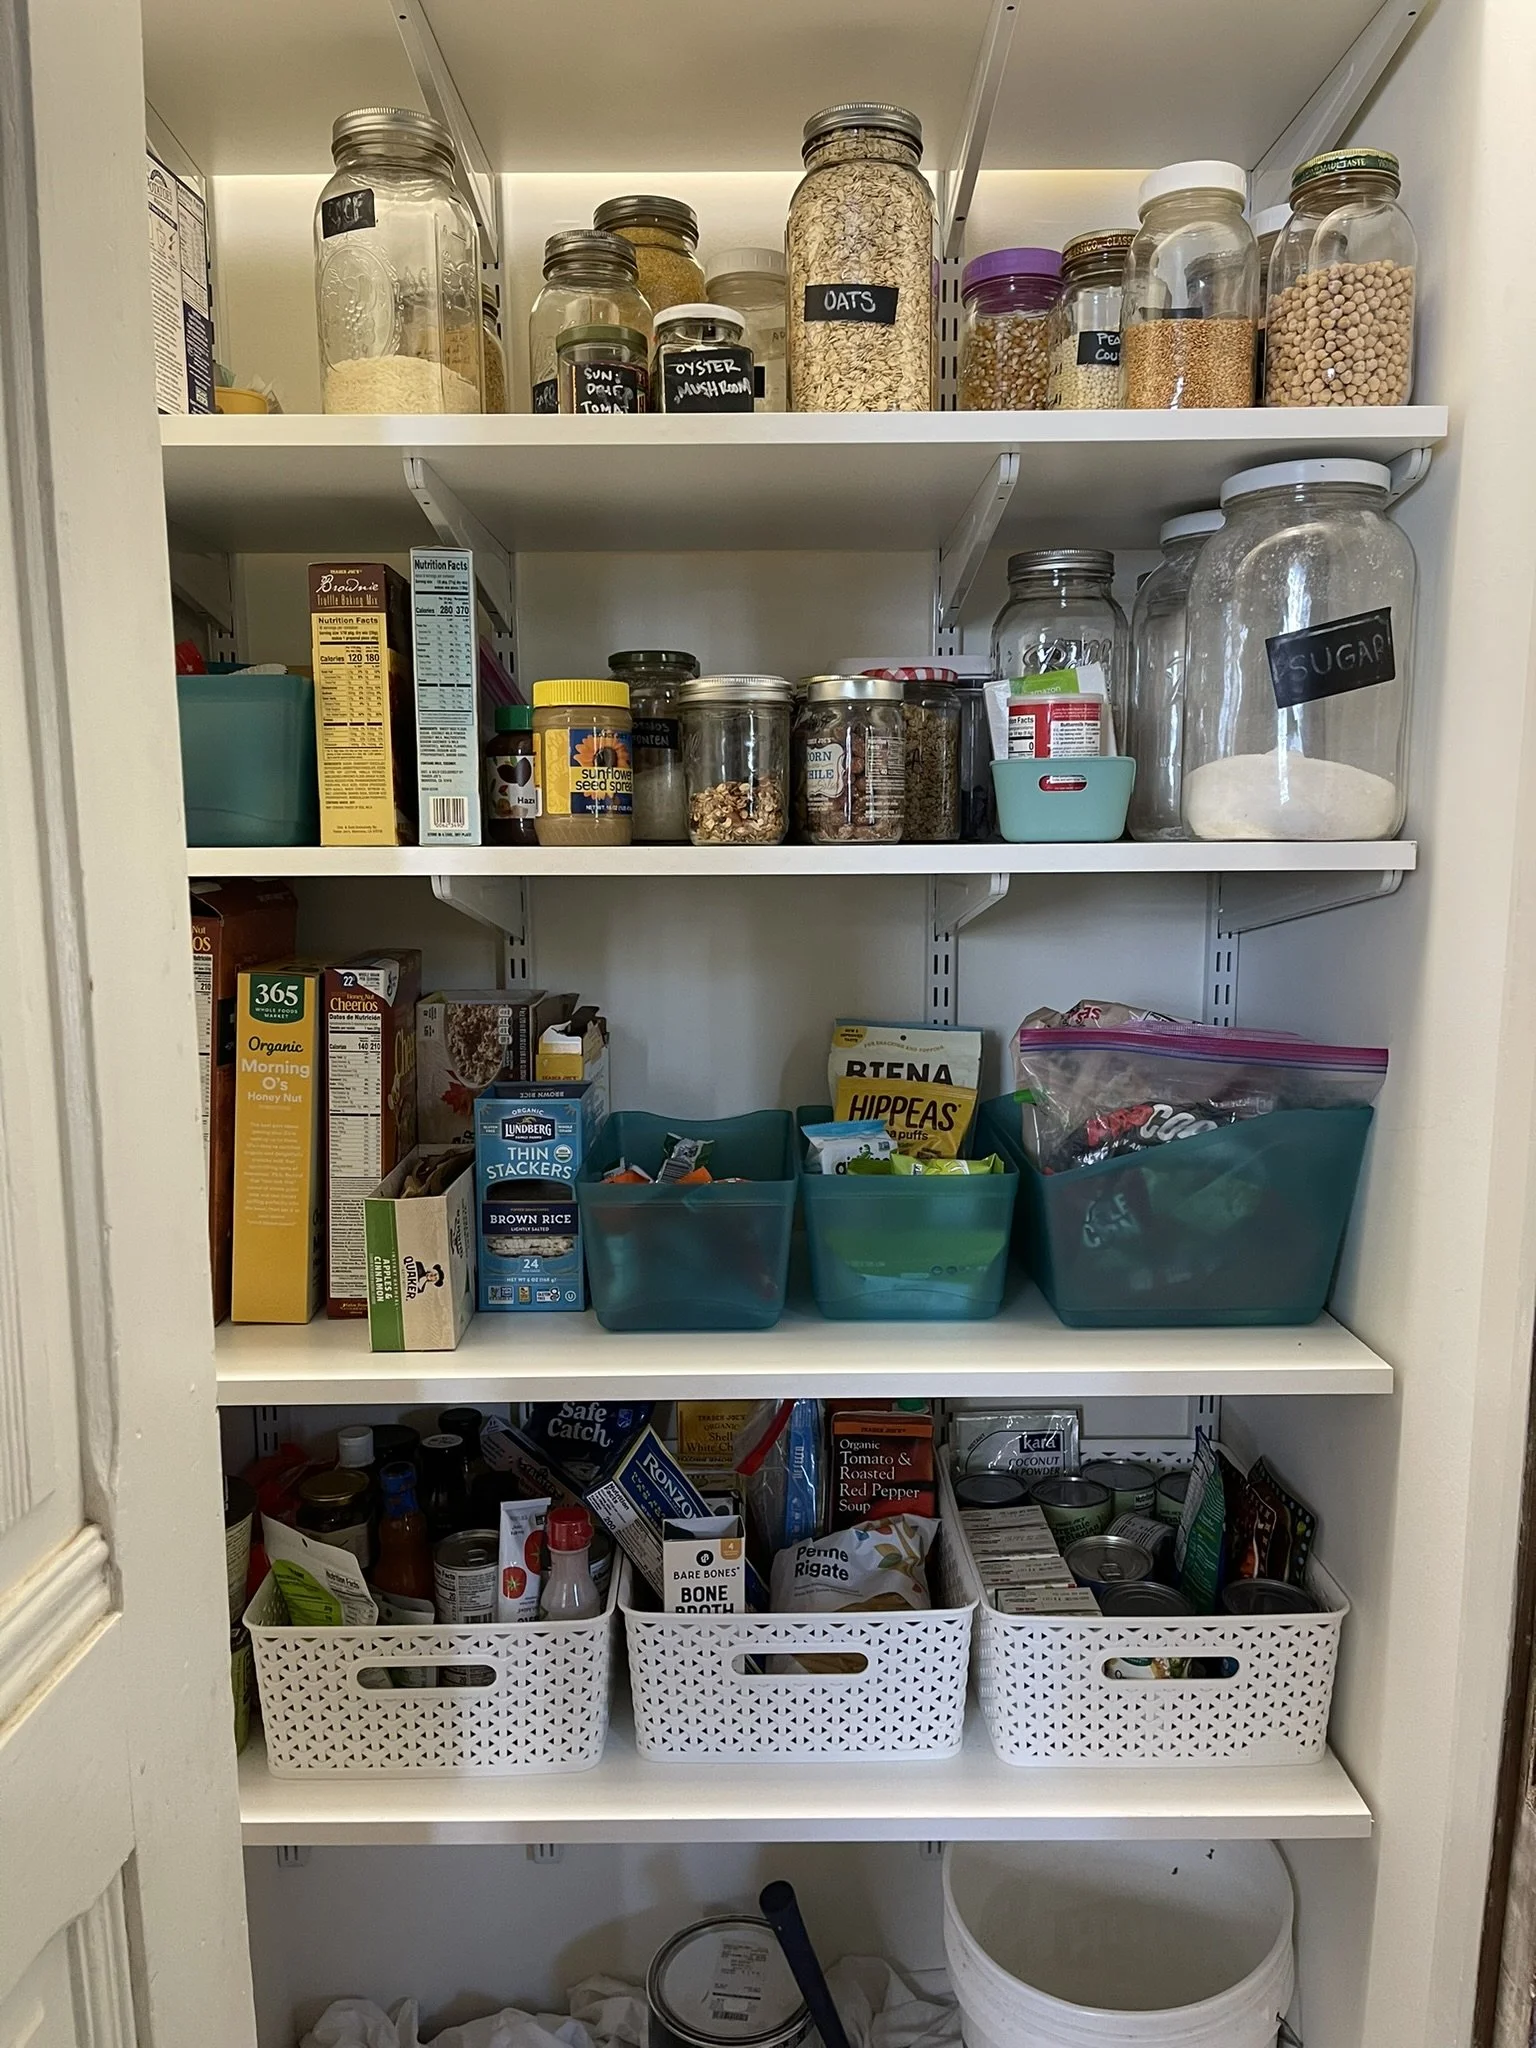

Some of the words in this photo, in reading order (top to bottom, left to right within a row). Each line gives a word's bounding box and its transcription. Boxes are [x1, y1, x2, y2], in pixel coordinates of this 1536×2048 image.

[824, 290, 877, 313] OATS
[675, 359, 742, 377] OYSTER
[676, 377, 753, 400] MUSHROOM
[414, 560, 447, 570] Nutrition
[447, 560, 468, 571] Facts
[316, 574, 379, 593] Brownie
[317, 594, 339, 606] Truffle
[341, 594, 364, 608] Baking
[366, 594, 378, 606] Mix
[440, 605, 453, 614] 280
[455, 606, 470, 615] 370
[318, 617, 354, 625] Nutrition
[356, 617, 379, 625] Facts
[348, 653, 363, 662] 120
[365, 653, 380, 662] 180
[1288, 633, 1386, 679] SUGAR
[1017, 716, 1034, 724] Facts
[582, 768, 632, 781] sunflower
[575, 780, 607, 791] seed
[342, 975, 355, 987] 22
[254, 982, 299, 1007] 365
[329, 997, 379, 1012] Cheerios
[249, 1036, 304, 1057] Organic
[358, 1042, 369, 1050] 140
[370, 1042, 381, 1050] 210
[241, 1058, 311, 1078] Morning
[262, 1076, 288, 1091] O's
[247, 1092, 281, 1104] Honey
[283, 1093, 303, 1103] Nut
[511, 1107, 545, 1116] ORGANIC
[848, 1095, 957, 1131] HIPPEAS
[504, 1123, 552, 1138] LUNDBERG
[898, 1129, 929, 1141] puffs
[507, 1147, 549, 1160] THIN
[486, 1162, 573, 1179] STACKERS
[490, 1215, 538, 1224] BROWN
[542, 1215, 572, 1224] RICE
[523, 1259, 539, 1269] 24
[374, 1256, 384, 1302] CINNAMON
[382, 1259, 393, 1292] APPLES
[404, 1256, 417, 1300] QUAKER
[558, 1402, 608, 1423] Safe
[547, 1418, 612, 1448] Catch
[686, 1442, 714, 1452] White
[839, 1438, 881, 1452] Organic
[1023, 1433, 1056, 1451] kara
[839, 1451, 894, 1465] Tomato
[898, 1452, 912, 1466] &
[1009, 1457, 1060, 1467] COCONUT
[840, 1466, 896, 1481] Roasted
[642, 1453, 697, 1519] RONZO
[840, 1482, 867, 1497] Red
[872, 1482, 920, 1501] Pepper
[608, 1483, 630, 1511] Nutrition
[839, 1499, 871, 1515] Soup
[603, 1516, 616, 1531] 200
[796, 1546, 849, 1563] Penne
[674, 1570, 701, 1580] BARE
[704, 1568, 737, 1579] BONES
[794, 1560, 849, 1581] Rigate
[681, 1585, 728, 1603] BONE
